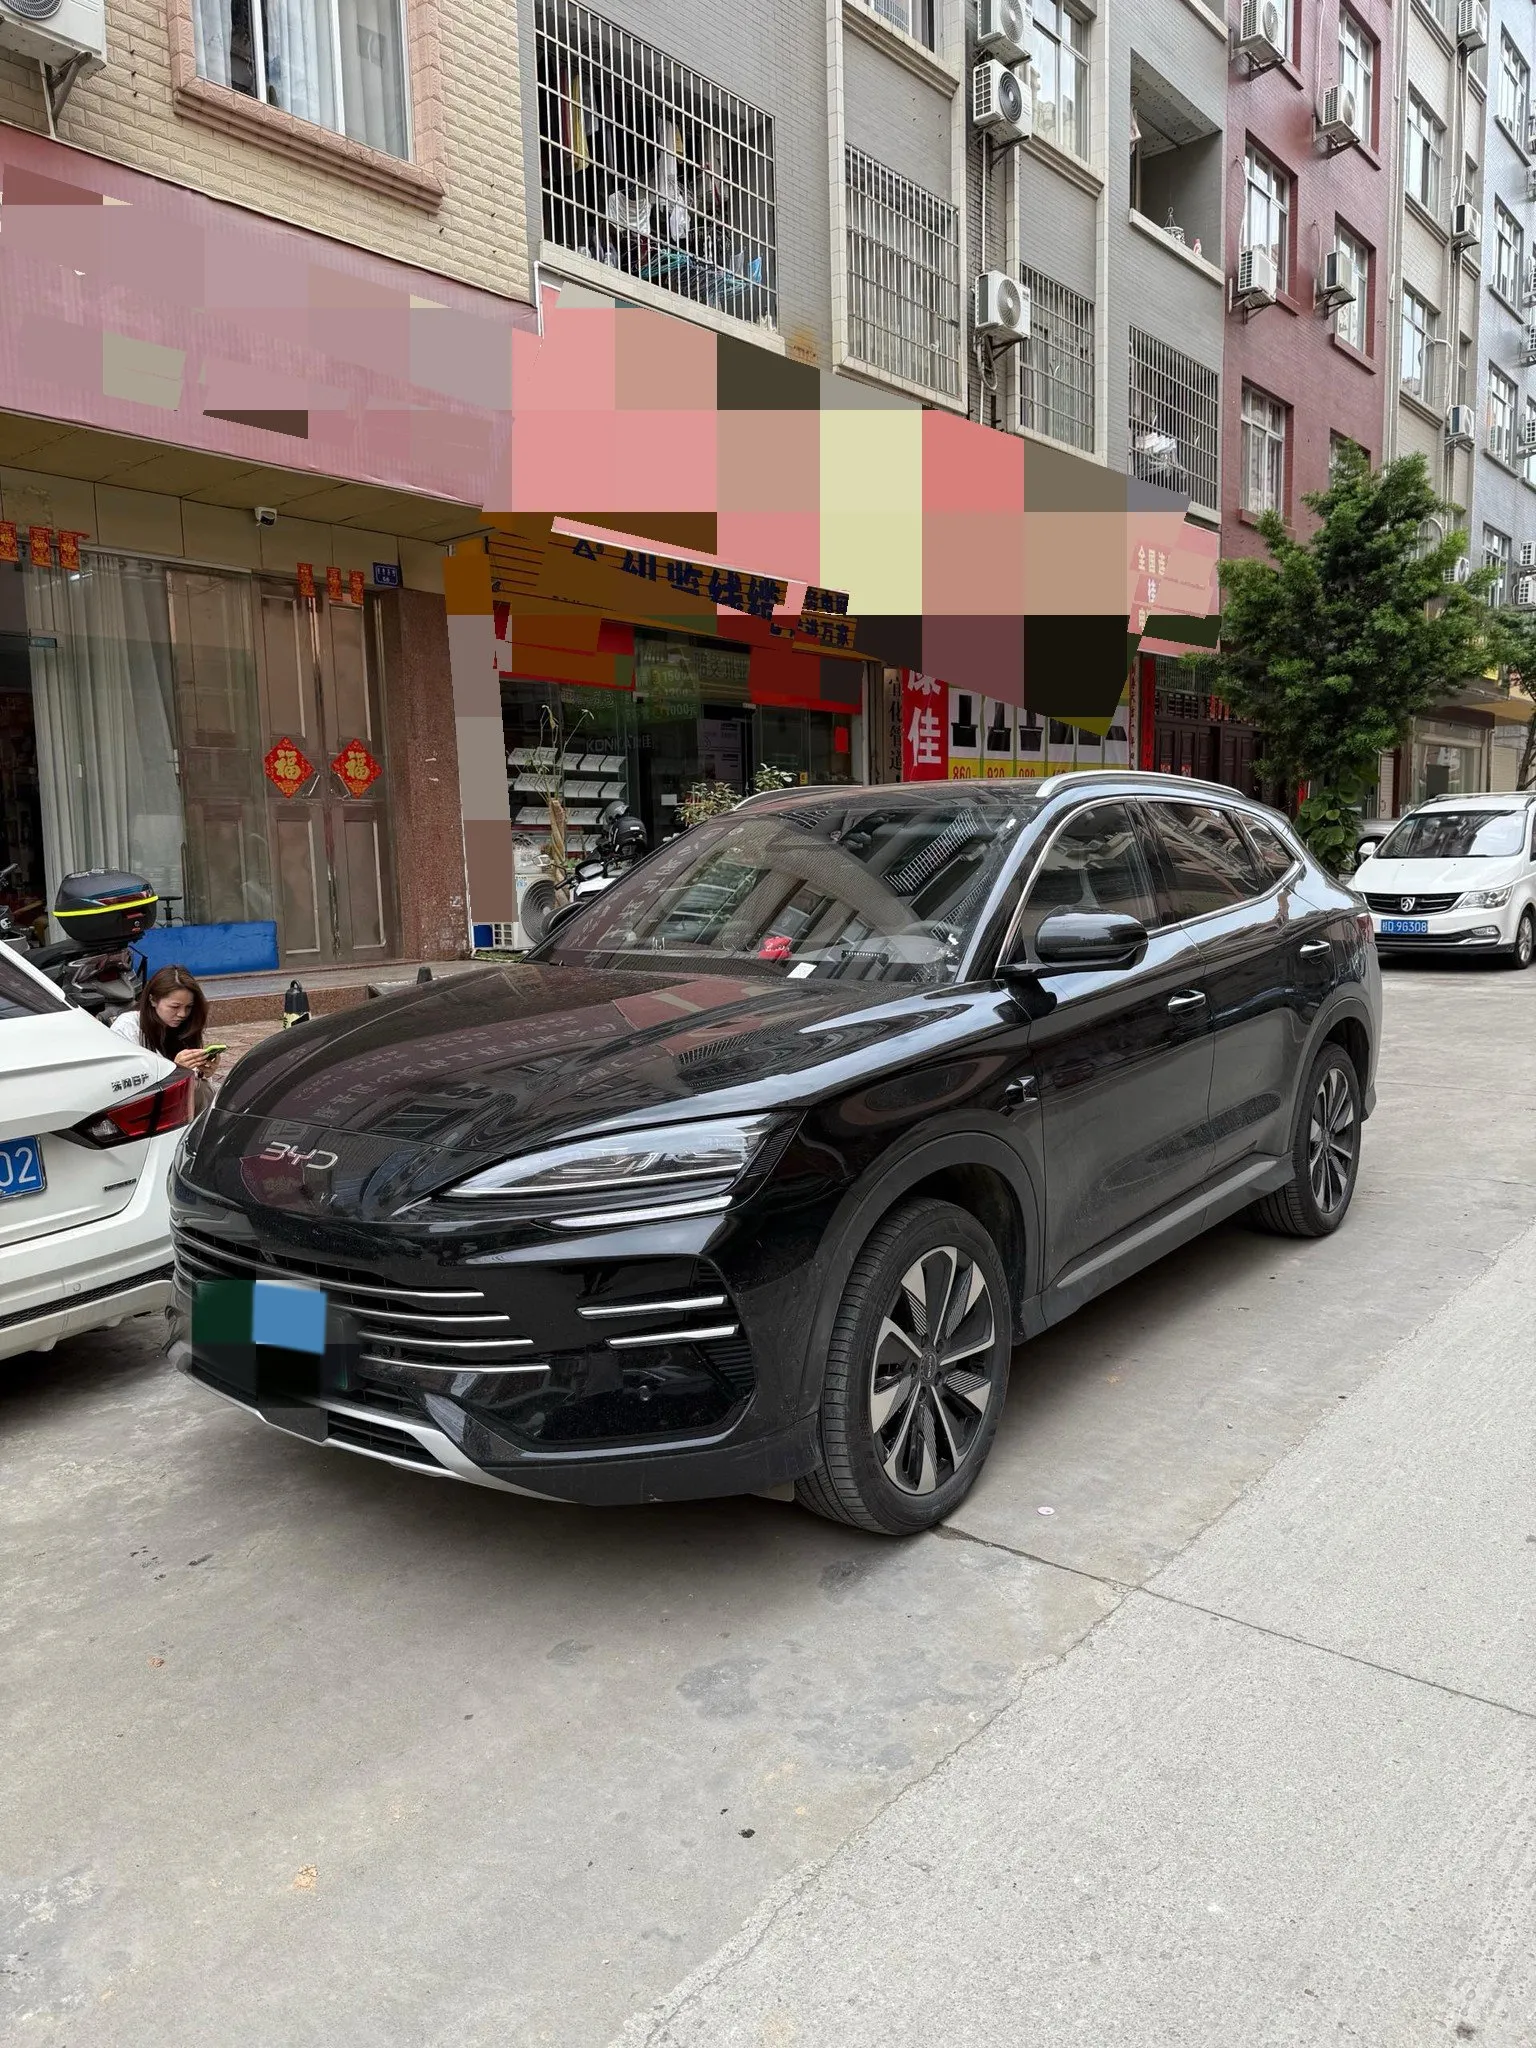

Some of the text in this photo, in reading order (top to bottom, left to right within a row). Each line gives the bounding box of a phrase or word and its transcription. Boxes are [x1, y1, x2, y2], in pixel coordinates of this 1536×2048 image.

[274, 749, 301, 780] 福
[345, 751, 370, 780] 福
[259, 1141, 339, 1170] BYD
